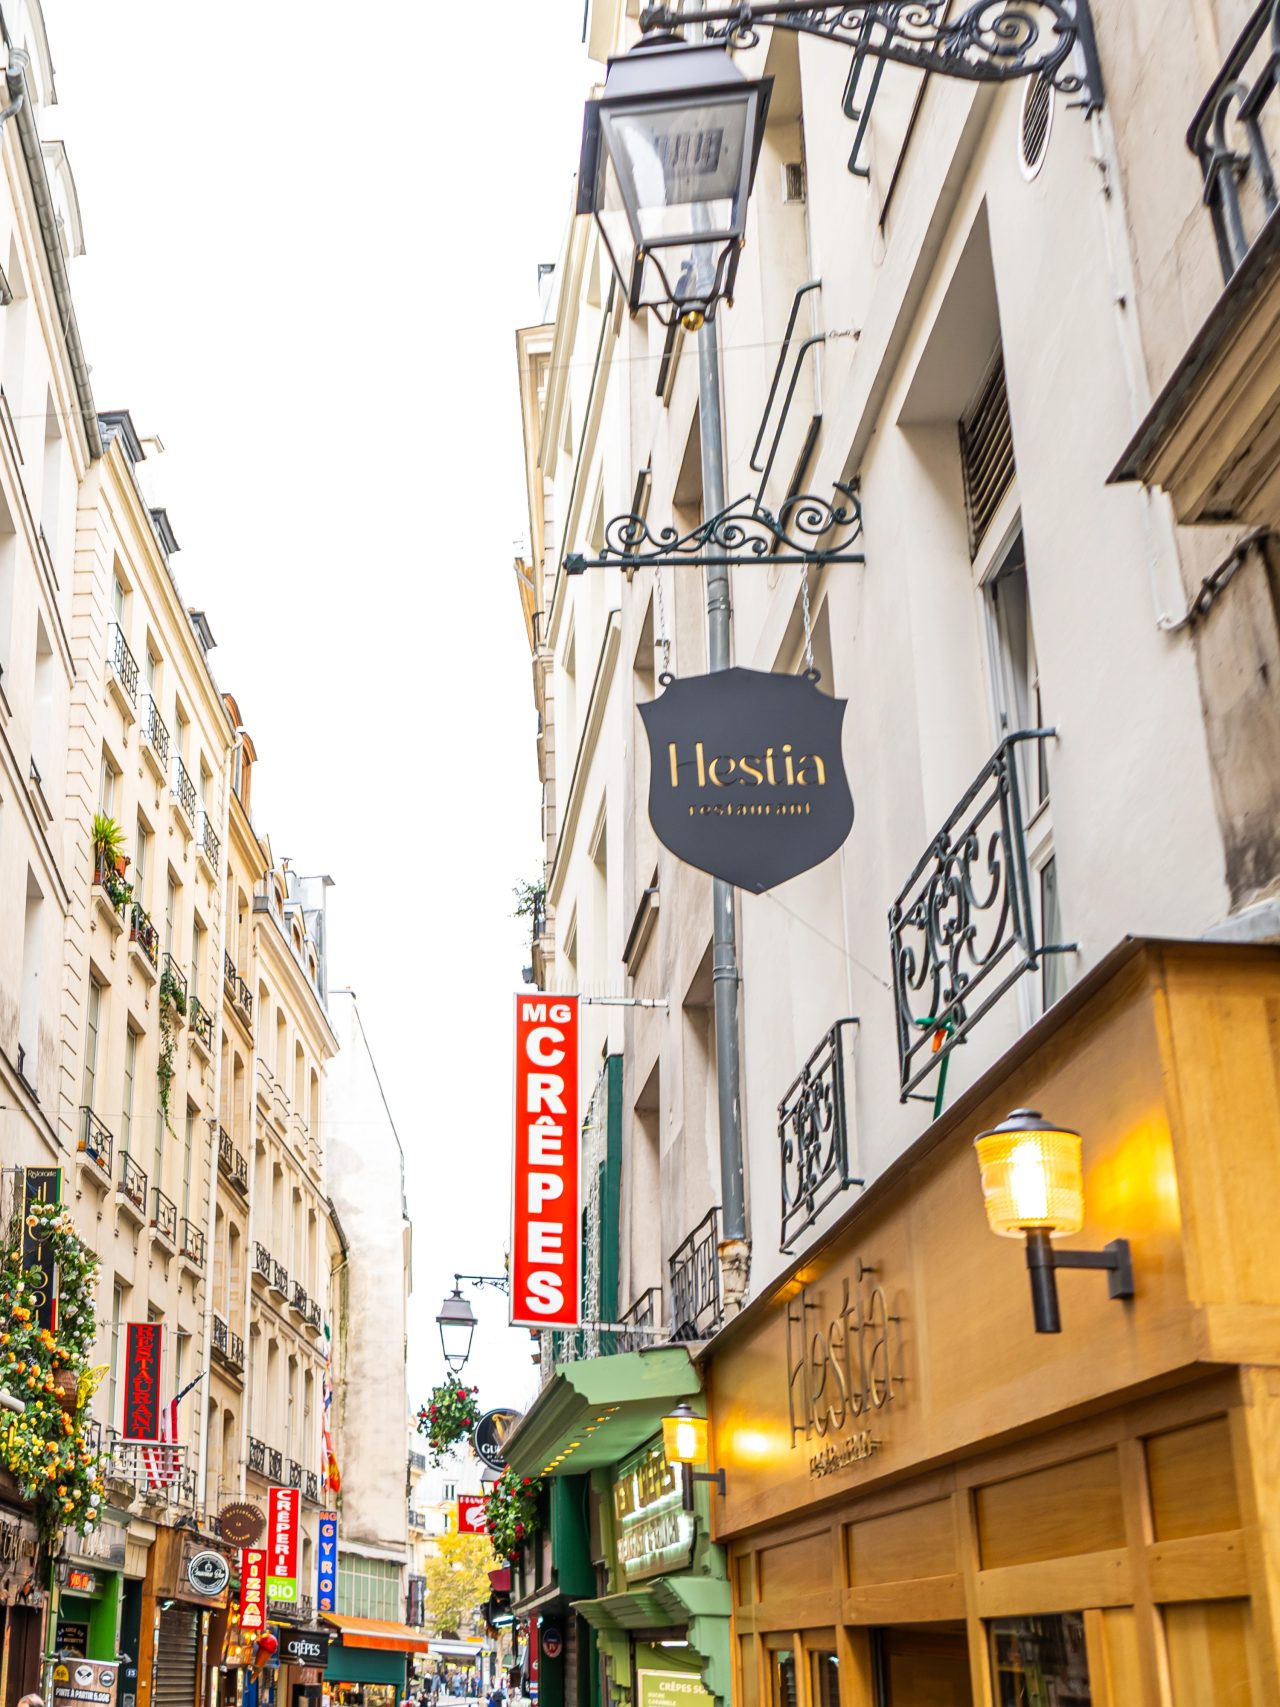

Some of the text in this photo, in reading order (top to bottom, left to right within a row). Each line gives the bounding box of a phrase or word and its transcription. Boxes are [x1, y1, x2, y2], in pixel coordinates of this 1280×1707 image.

[668, 741, 826, 788] Hestia
[688, 802, 813, 817] restaurant
[522, 1003, 572, 1023] MG
[525, 1026, 568, 1315] CRÊPES
[130, 1325, 155, 1439] RESTAURANT
[320, 1511, 337, 1521] MG
[320, 1524, 335, 1611] GYROS
[243, 1552, 262, 1616] PIZZA
[268, 1584, 294, 1599] BIO
[287, 1639, 321, 1657] CRÊPES
[659, 1681, 692, 1694] CRÊPES
